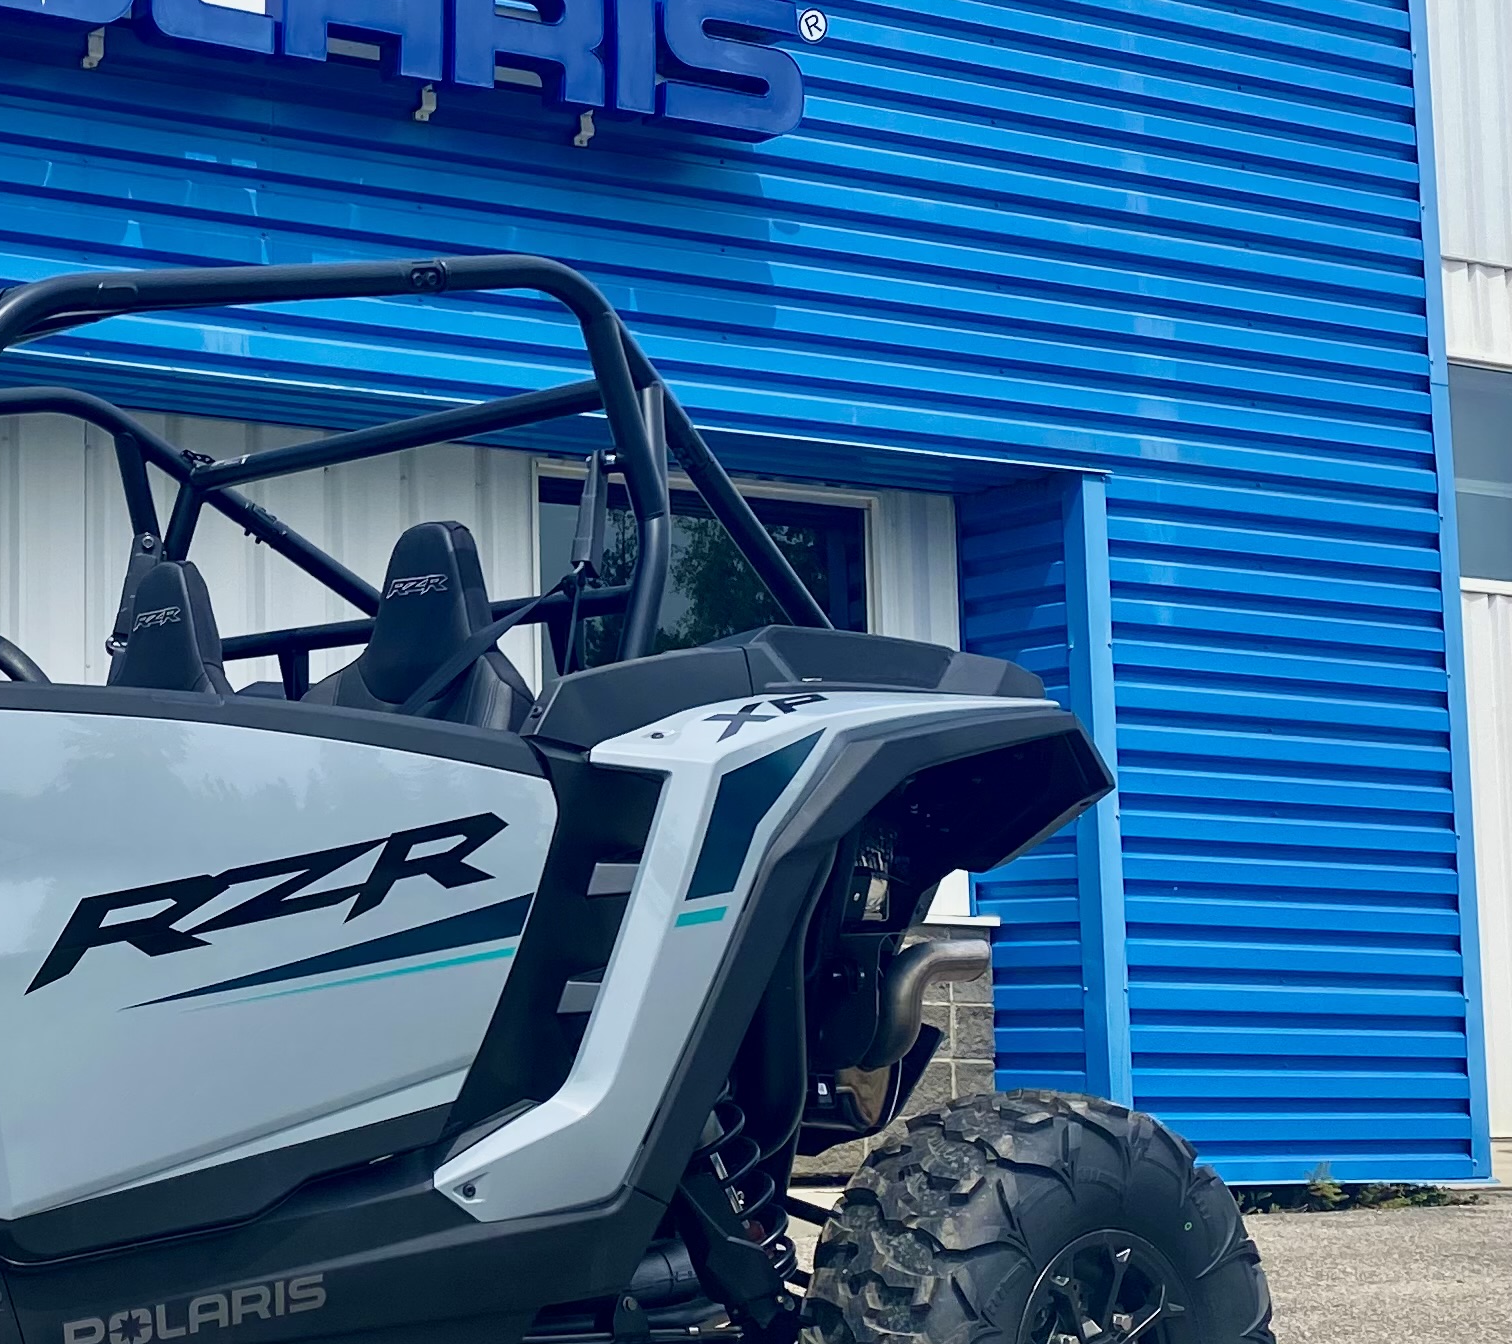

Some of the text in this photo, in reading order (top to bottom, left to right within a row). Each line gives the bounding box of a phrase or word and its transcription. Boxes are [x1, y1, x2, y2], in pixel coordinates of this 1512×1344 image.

[385, 573, 449, 600] RZR
[133, 606, 181, 632] RZR
[701, 693, 829, 744] XP
[23, 810, 508, 996] RZR
